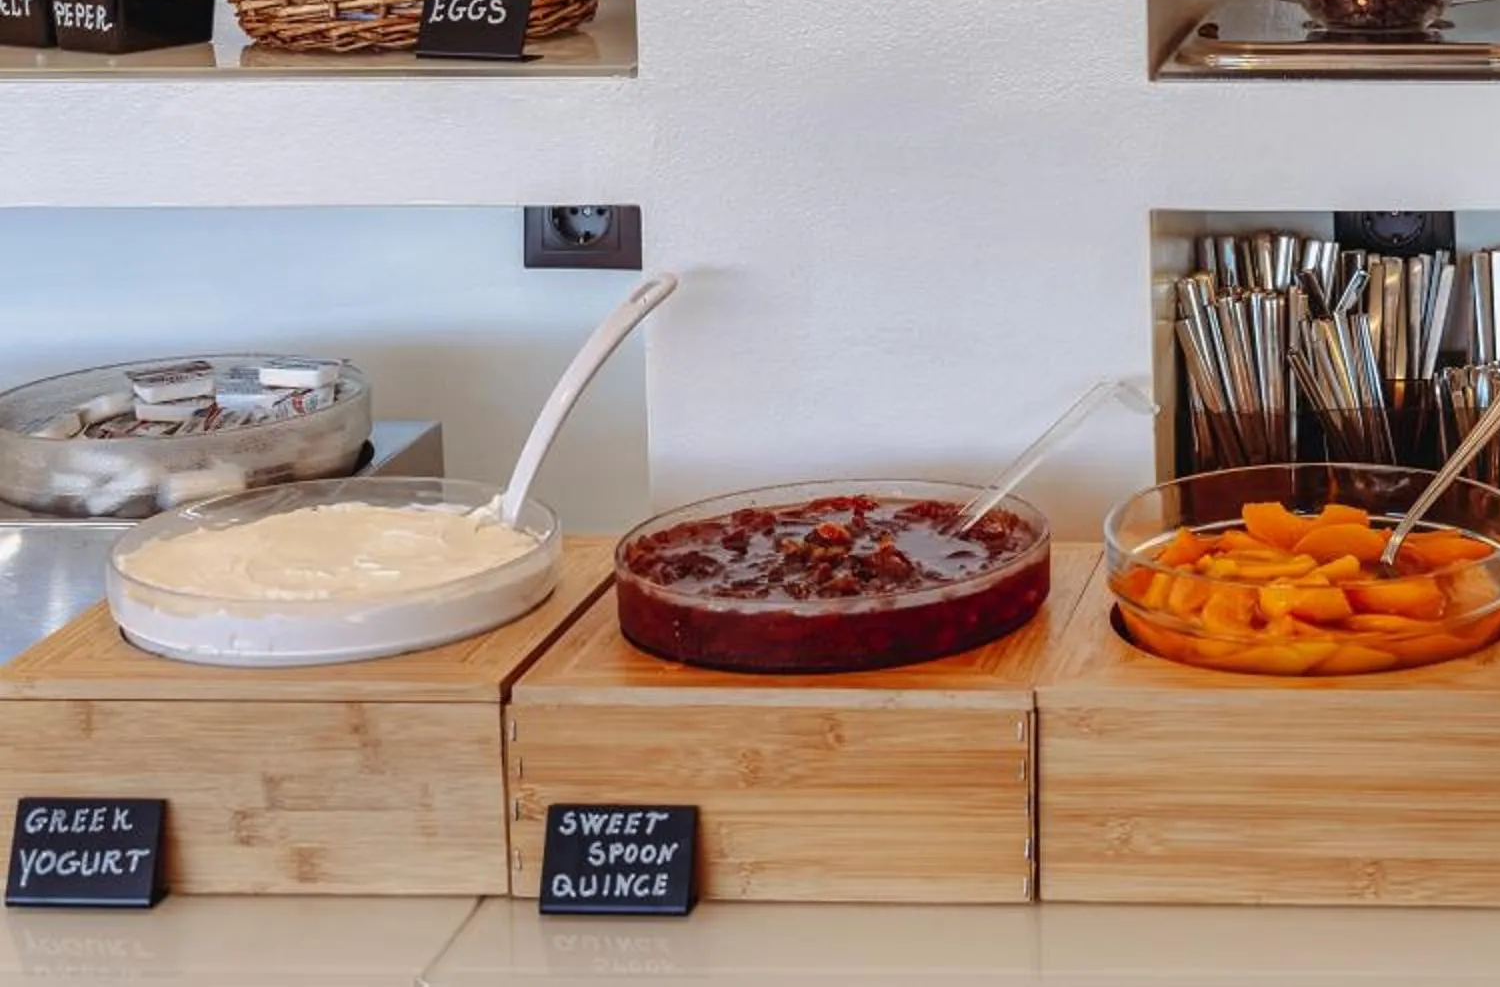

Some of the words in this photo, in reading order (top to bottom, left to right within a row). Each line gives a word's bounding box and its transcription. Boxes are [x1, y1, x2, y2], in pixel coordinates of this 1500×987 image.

[53, 0, 113, 32] PEPER
[25, 807, 133, 834] GREEK
[559, 811, 669, 836] SWEET
[587, 841, 679, 866] SPOON
[19, 848, 150, 887] YOGURT
[552, 873, 669, 898] QUINCE
